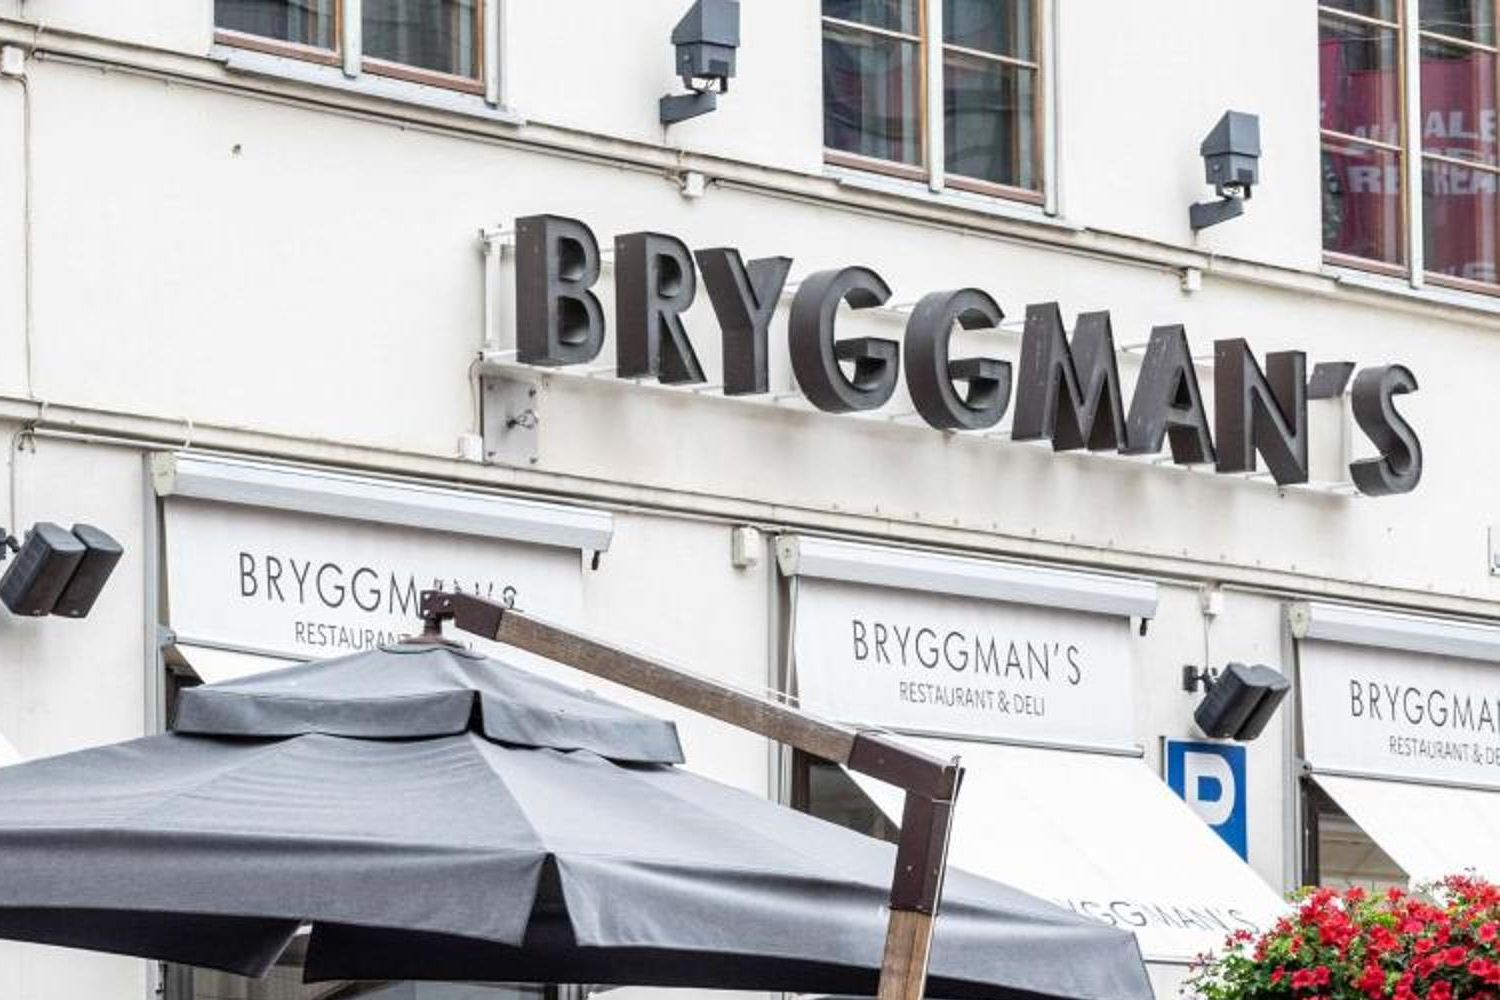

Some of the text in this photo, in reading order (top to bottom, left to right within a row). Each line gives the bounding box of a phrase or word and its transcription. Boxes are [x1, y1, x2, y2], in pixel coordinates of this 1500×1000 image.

[513, 212, 1425, 497] BRYGGMAN'S
[294, 621, 411, 651] RESTAURAN
[852, 619, 1082, 685] BRYGGMAN'S
[899, 681, 1045, 717] RESTAURANT & DELI
[1349, 679, 1500, 734] BRYGGMA
[1389, 735, 1500, 766] RESTAURANT & DE
